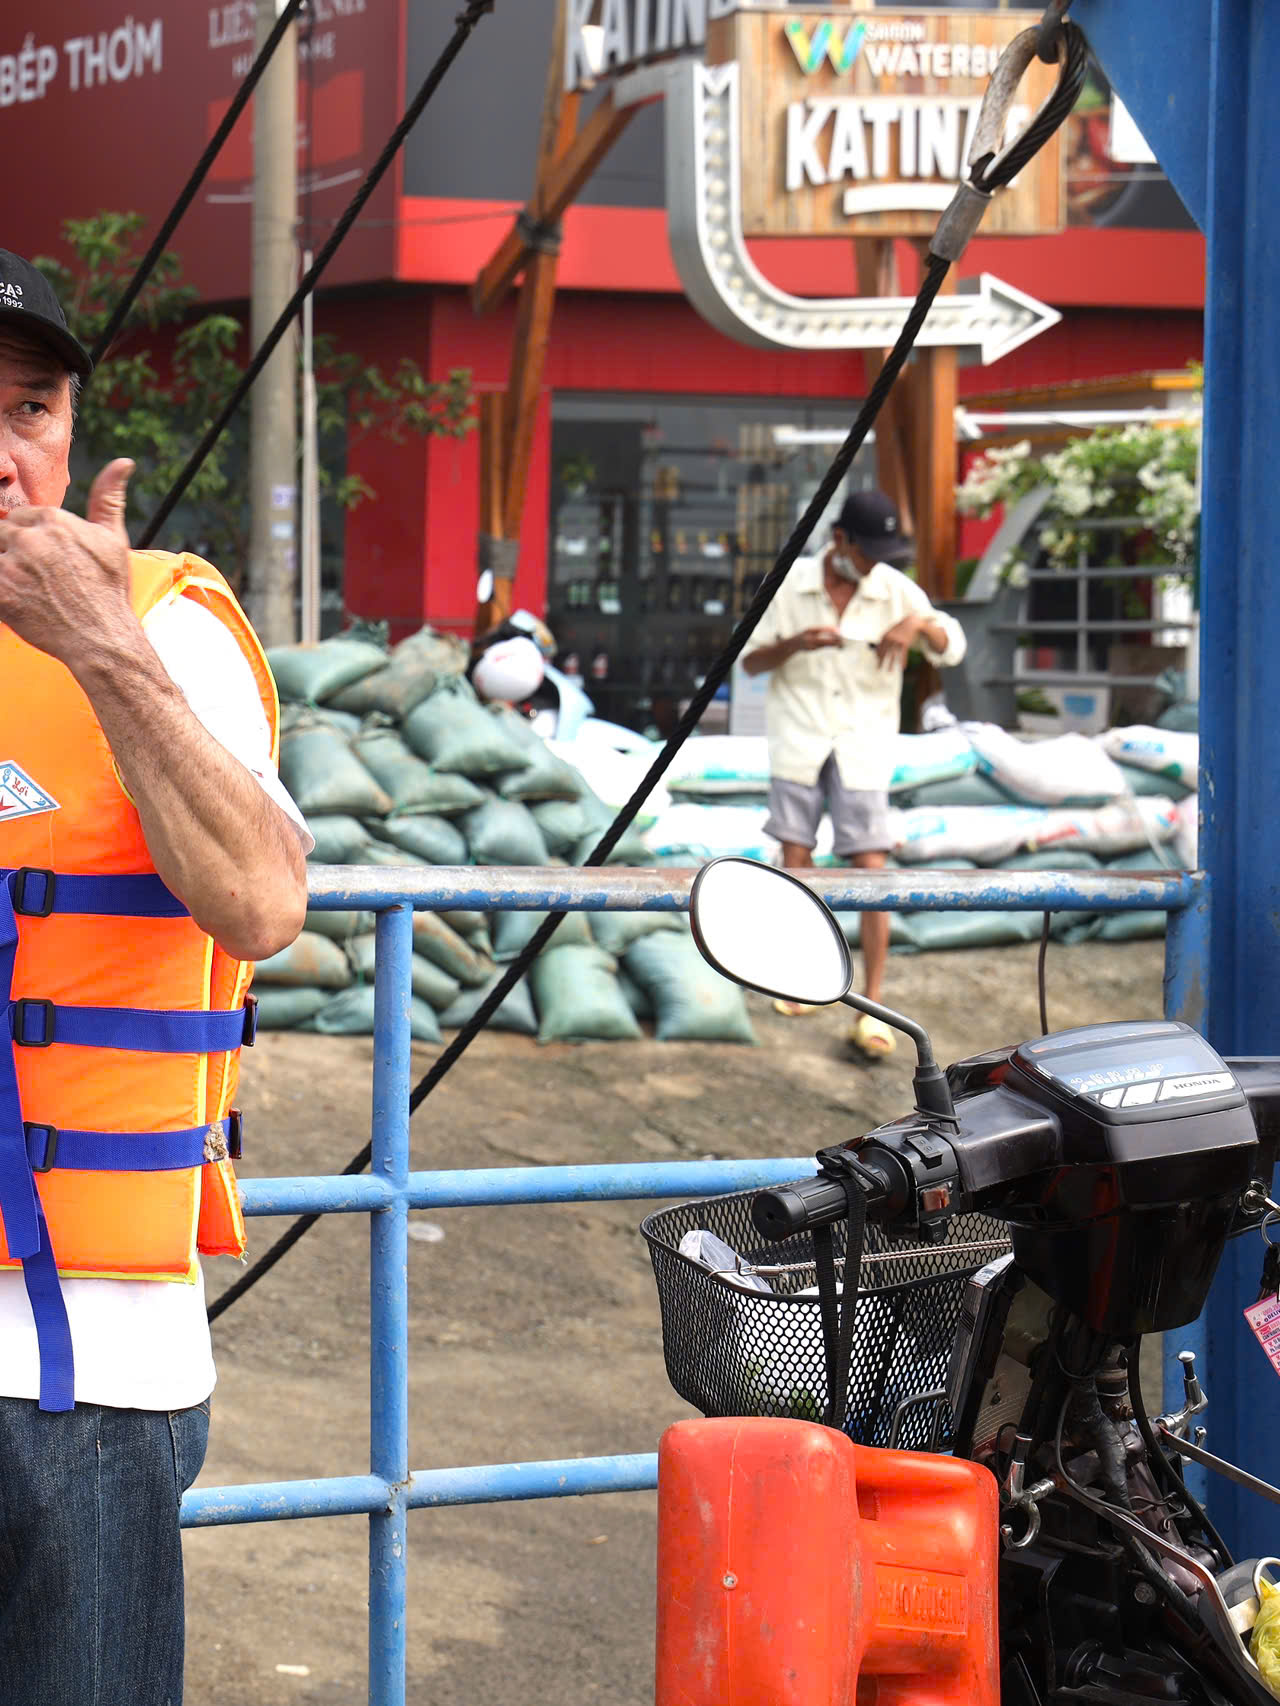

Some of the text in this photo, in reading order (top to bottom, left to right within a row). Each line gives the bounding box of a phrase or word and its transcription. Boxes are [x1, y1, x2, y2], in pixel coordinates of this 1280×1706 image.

[64, 15, 163, 91] THƠM
[2, 296, 25, 310] 1992
[1173, 1078, 1221, 1090] HONDA
